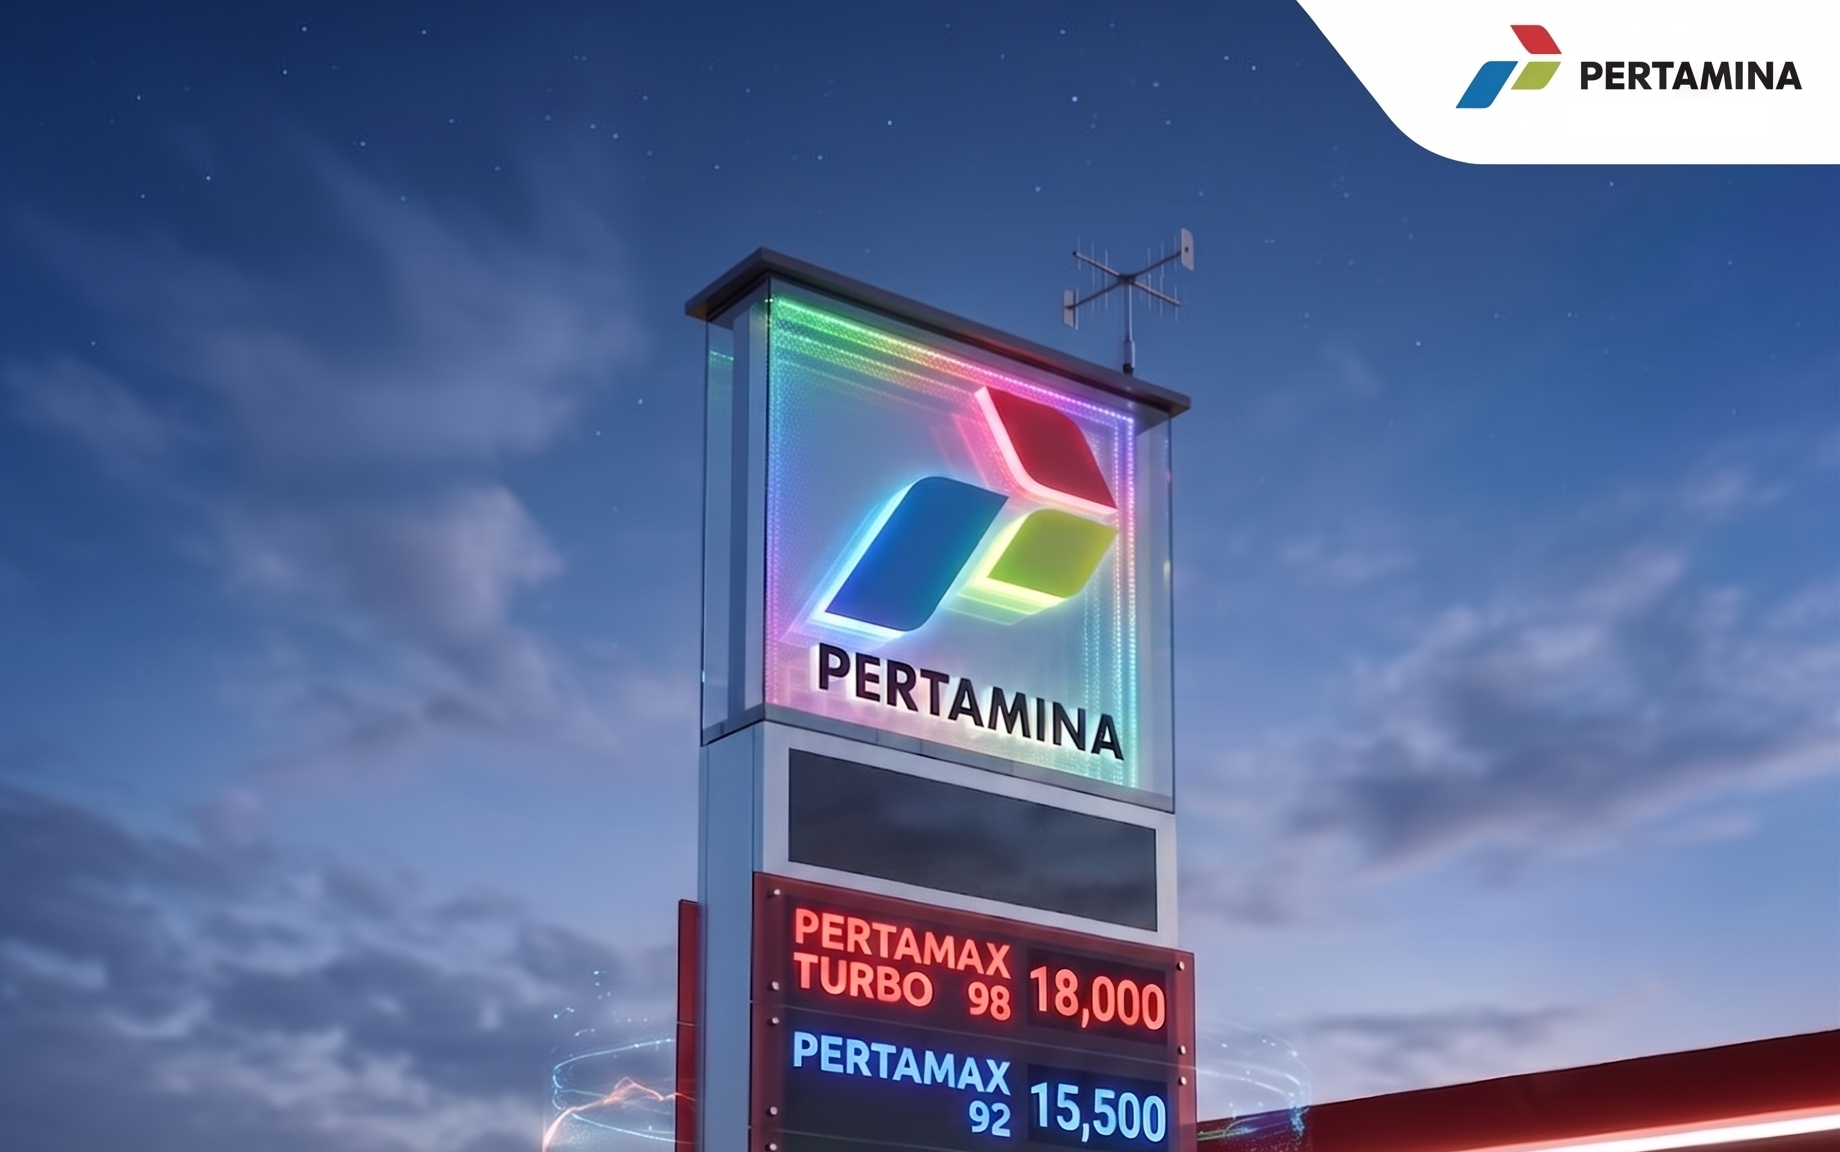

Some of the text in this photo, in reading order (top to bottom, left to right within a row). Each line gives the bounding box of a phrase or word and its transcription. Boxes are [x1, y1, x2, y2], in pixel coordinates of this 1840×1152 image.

[818, 642, 1125, 761] PERTAMINA
[794, 908, 1011, 979] PERTAMAX
[793, 953, 1011, 1021] TURBO 98
[1029, 966, 1166, 1030] 18,000
[793, 1031, 1011, 1096] PERTAMAX
[969, 1100, 1011, 1138] 92
[1030, 1082, 1167, 1143] 15,500
